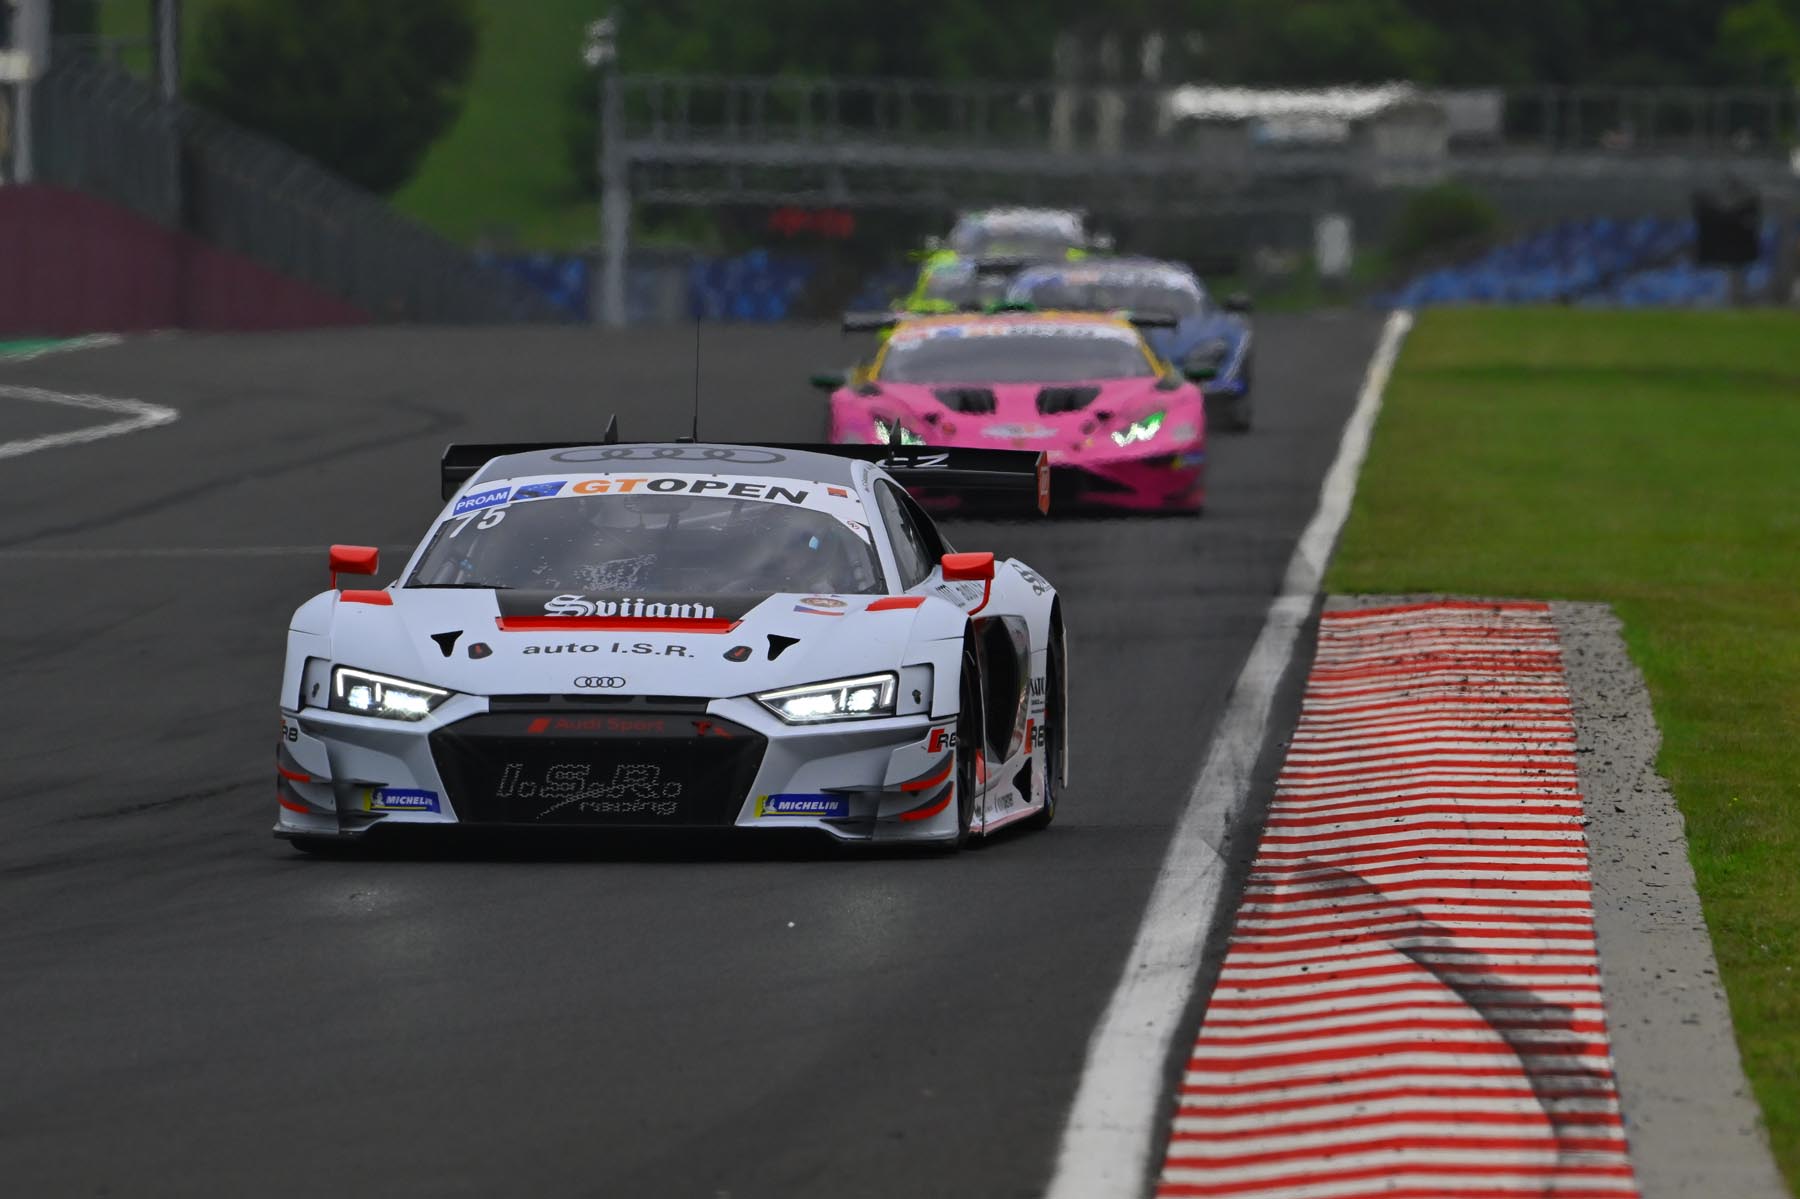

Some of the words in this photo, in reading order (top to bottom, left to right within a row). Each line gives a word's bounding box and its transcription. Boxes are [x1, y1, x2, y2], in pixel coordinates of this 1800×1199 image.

[456, 492, 508, 511] PROAM
[449, 503, 511, 538] 75
[522, 642, 599, 655] auto
[611, 642, 696, 658] I.S.R.
[555, 718, 601, 731] Audi
[607, 718, 666, 733] Sport
[385, 795, 433, 806] MICHELIN
[778, 801, 839, 811] MICHELIN
